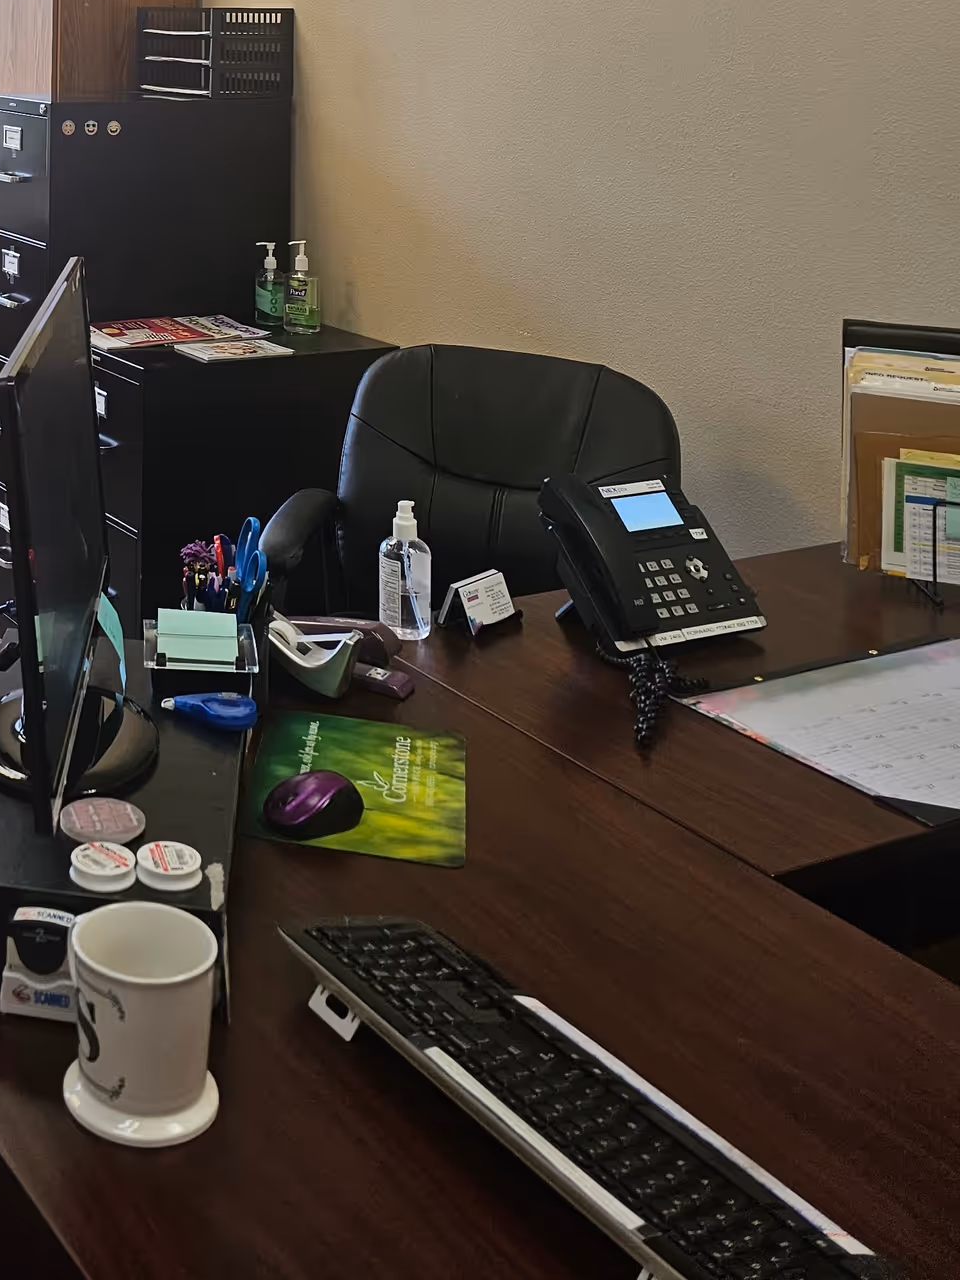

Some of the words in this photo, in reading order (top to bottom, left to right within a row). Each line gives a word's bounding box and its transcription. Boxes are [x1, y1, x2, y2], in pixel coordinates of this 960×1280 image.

[383, 736, 412, 803] Cornerstone
[36, 910, 73, 923] SCANNED
[33, 990, 71, 1008] SCANNED
